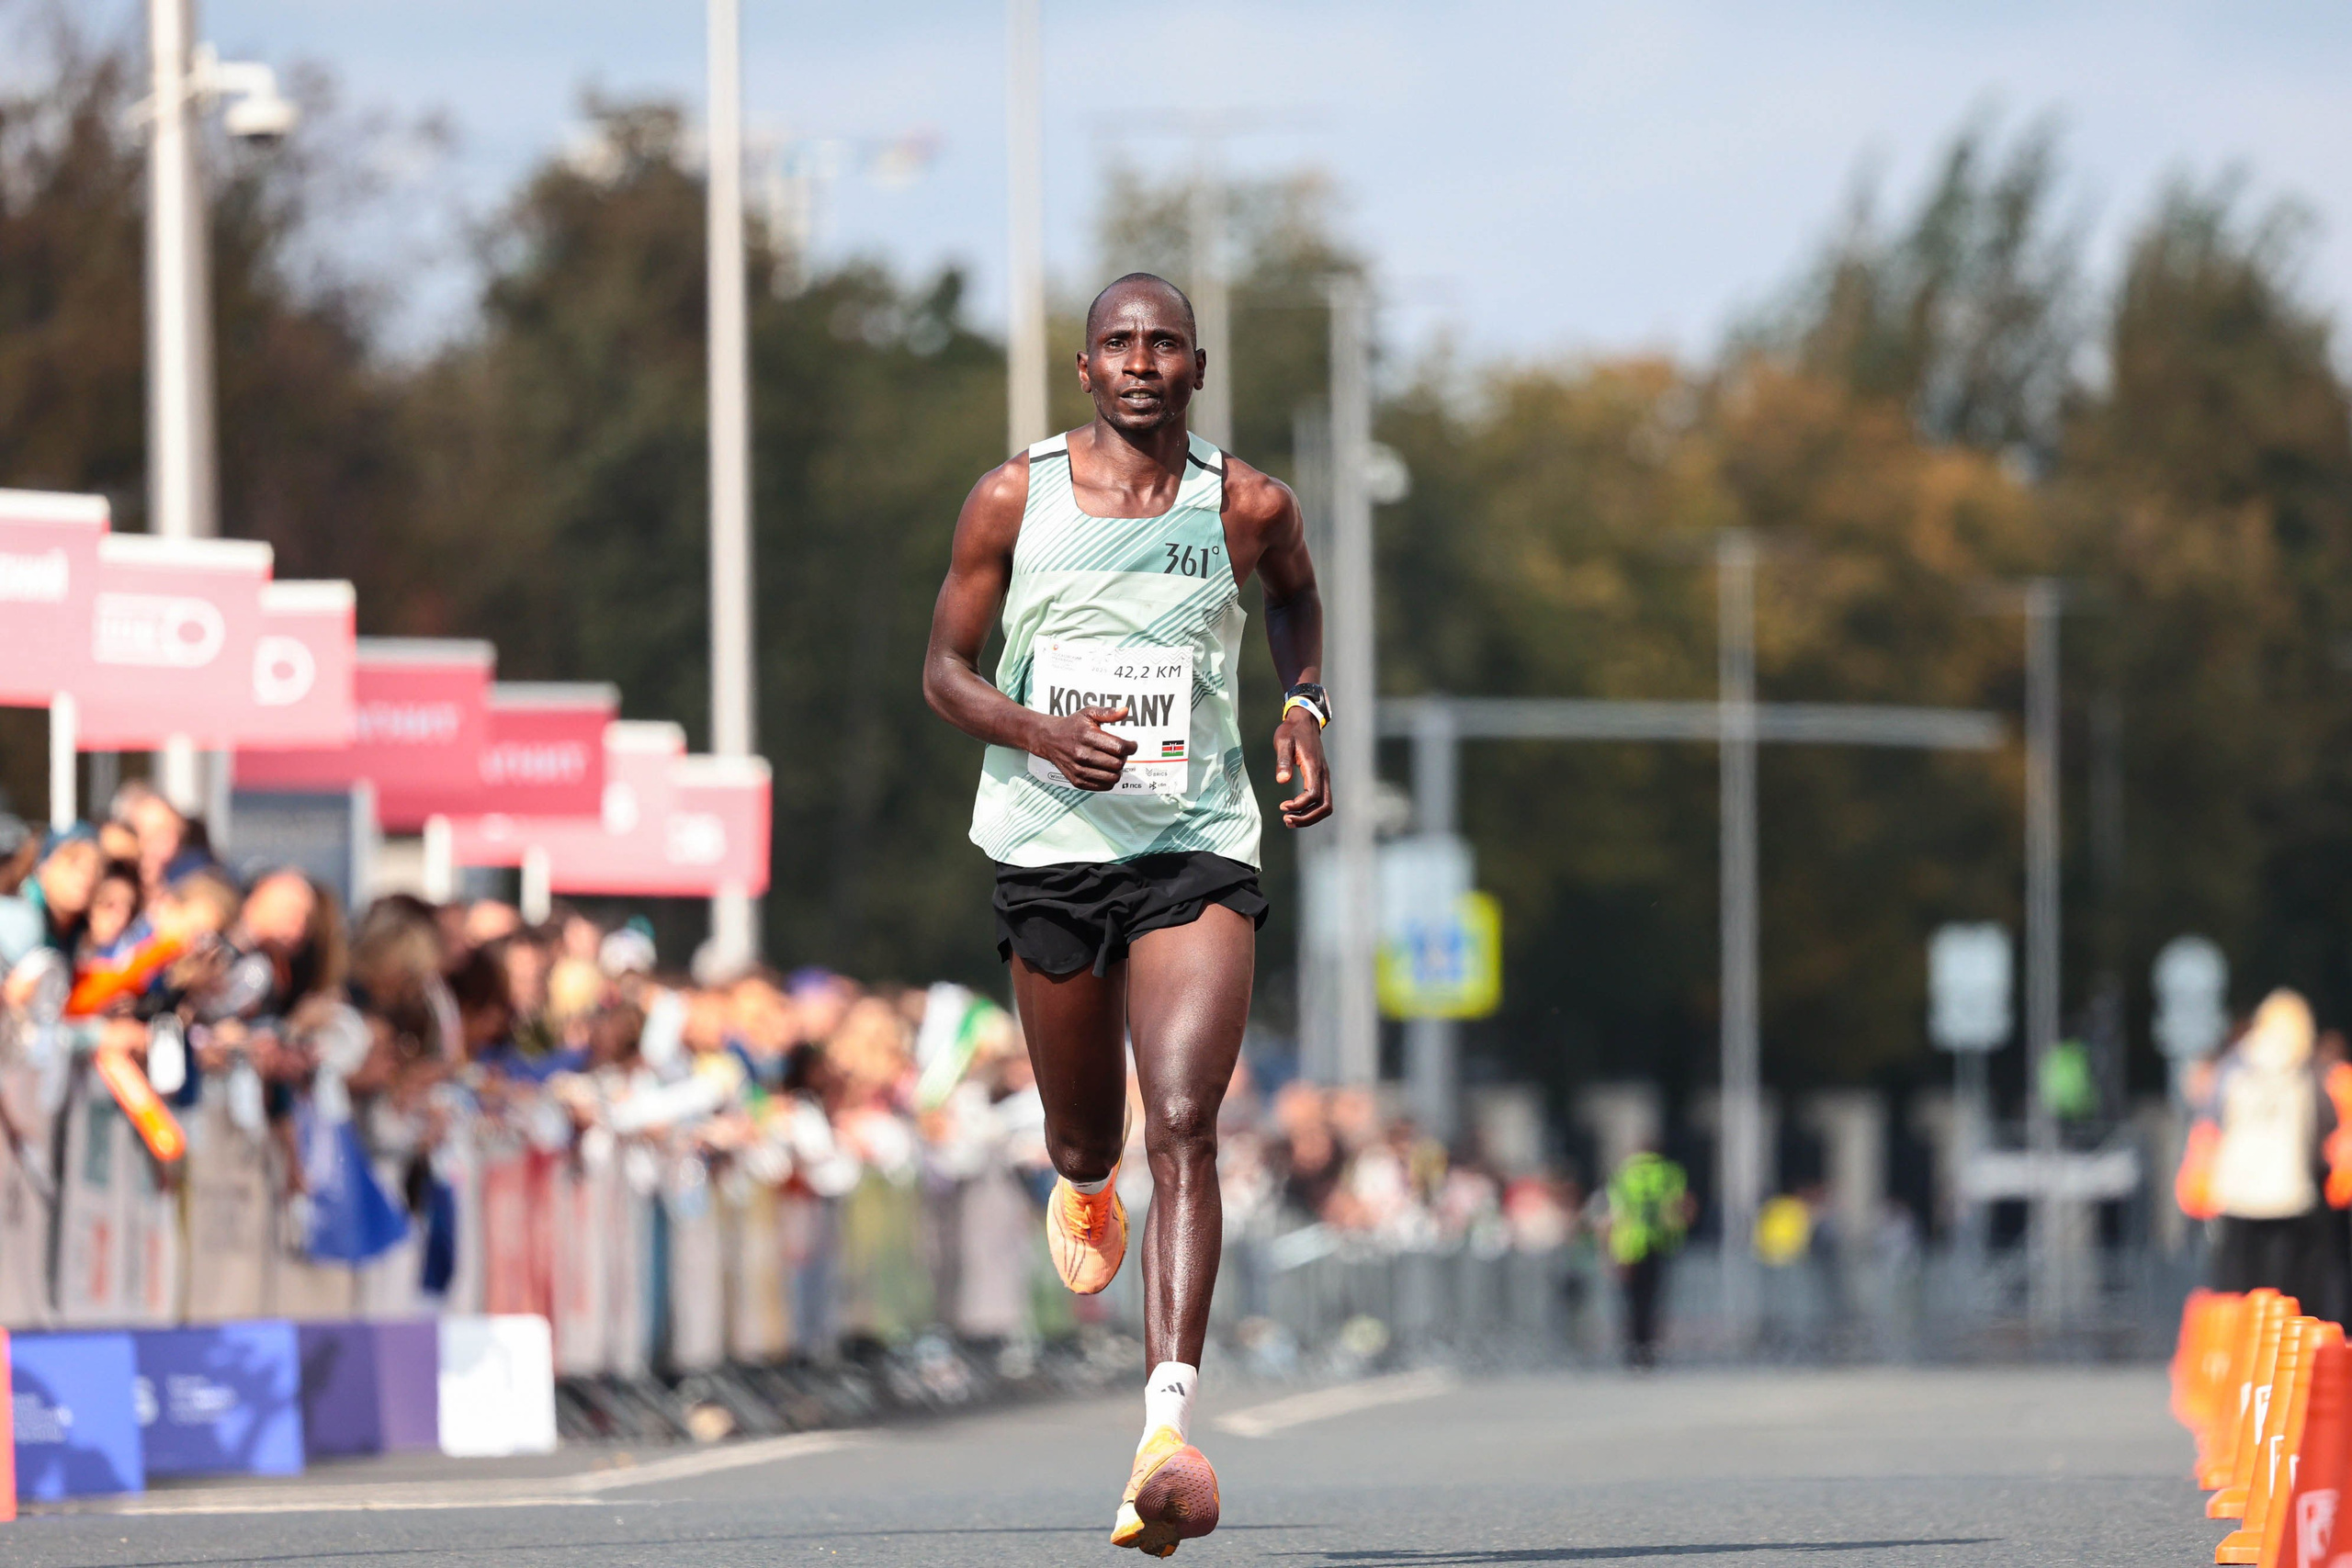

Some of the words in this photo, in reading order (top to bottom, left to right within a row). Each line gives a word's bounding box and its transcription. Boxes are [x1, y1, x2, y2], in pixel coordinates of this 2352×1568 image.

[1163, 543, 1219, 579] 361°
[1114, 665, 1149, 680] 42,2
[1156, 665, 1182, 678] KM
